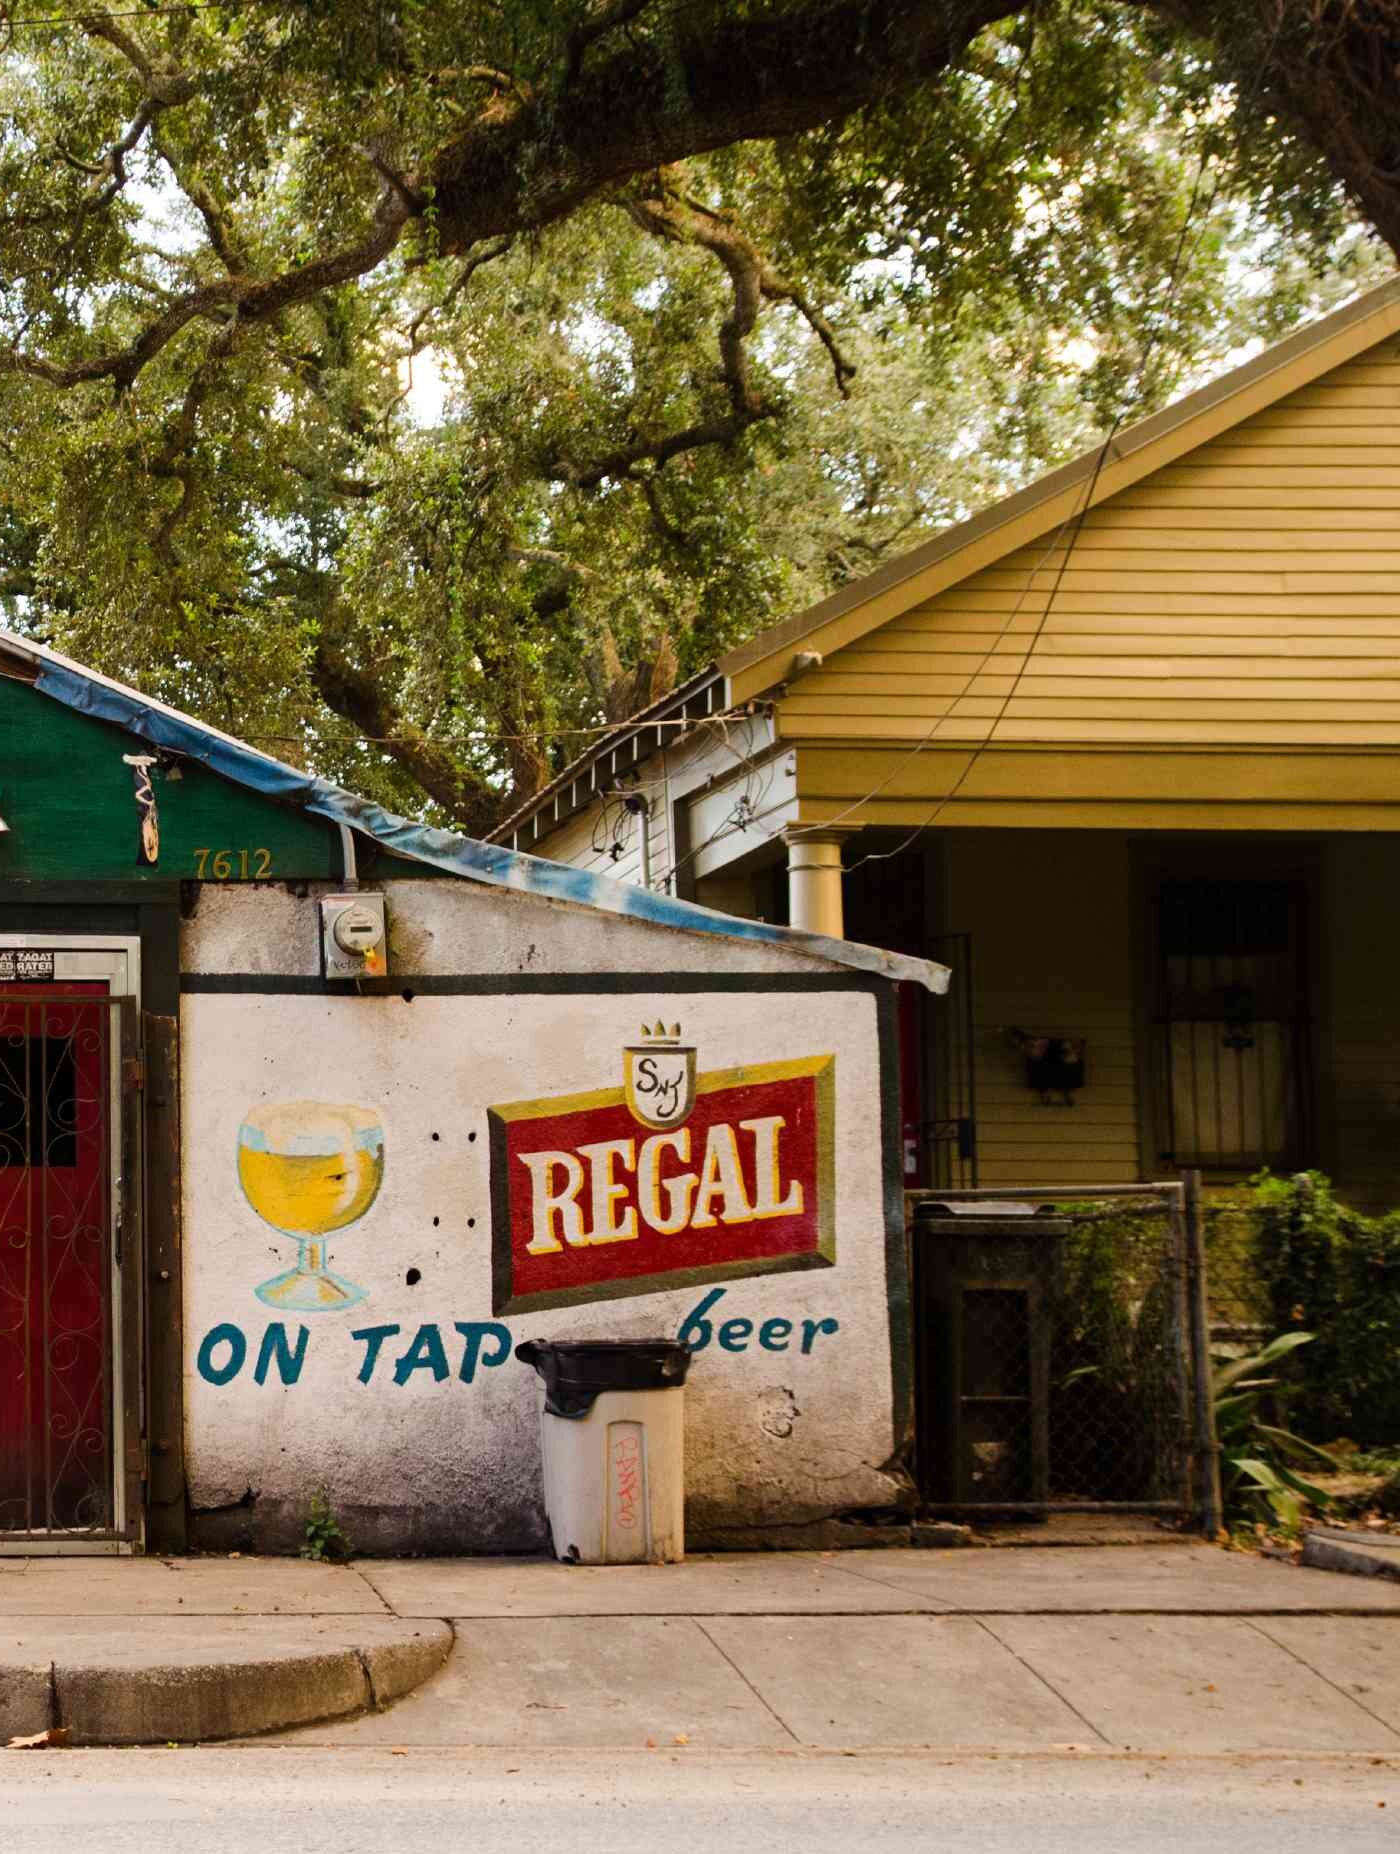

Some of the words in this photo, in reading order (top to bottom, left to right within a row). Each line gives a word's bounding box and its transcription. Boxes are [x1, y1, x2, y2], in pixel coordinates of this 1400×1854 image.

[193, 848, 273, 879] 7612
[16, 952, 53, 962] ZAGAT
[16, 962, 53, 971] RATED
[517, 1115, 804, 1255] REGAL
[676, 1288, 839, 1355] beer
[197, 1321, 311, 1385] ON
[351, 1321, 512, 1385] TAP
